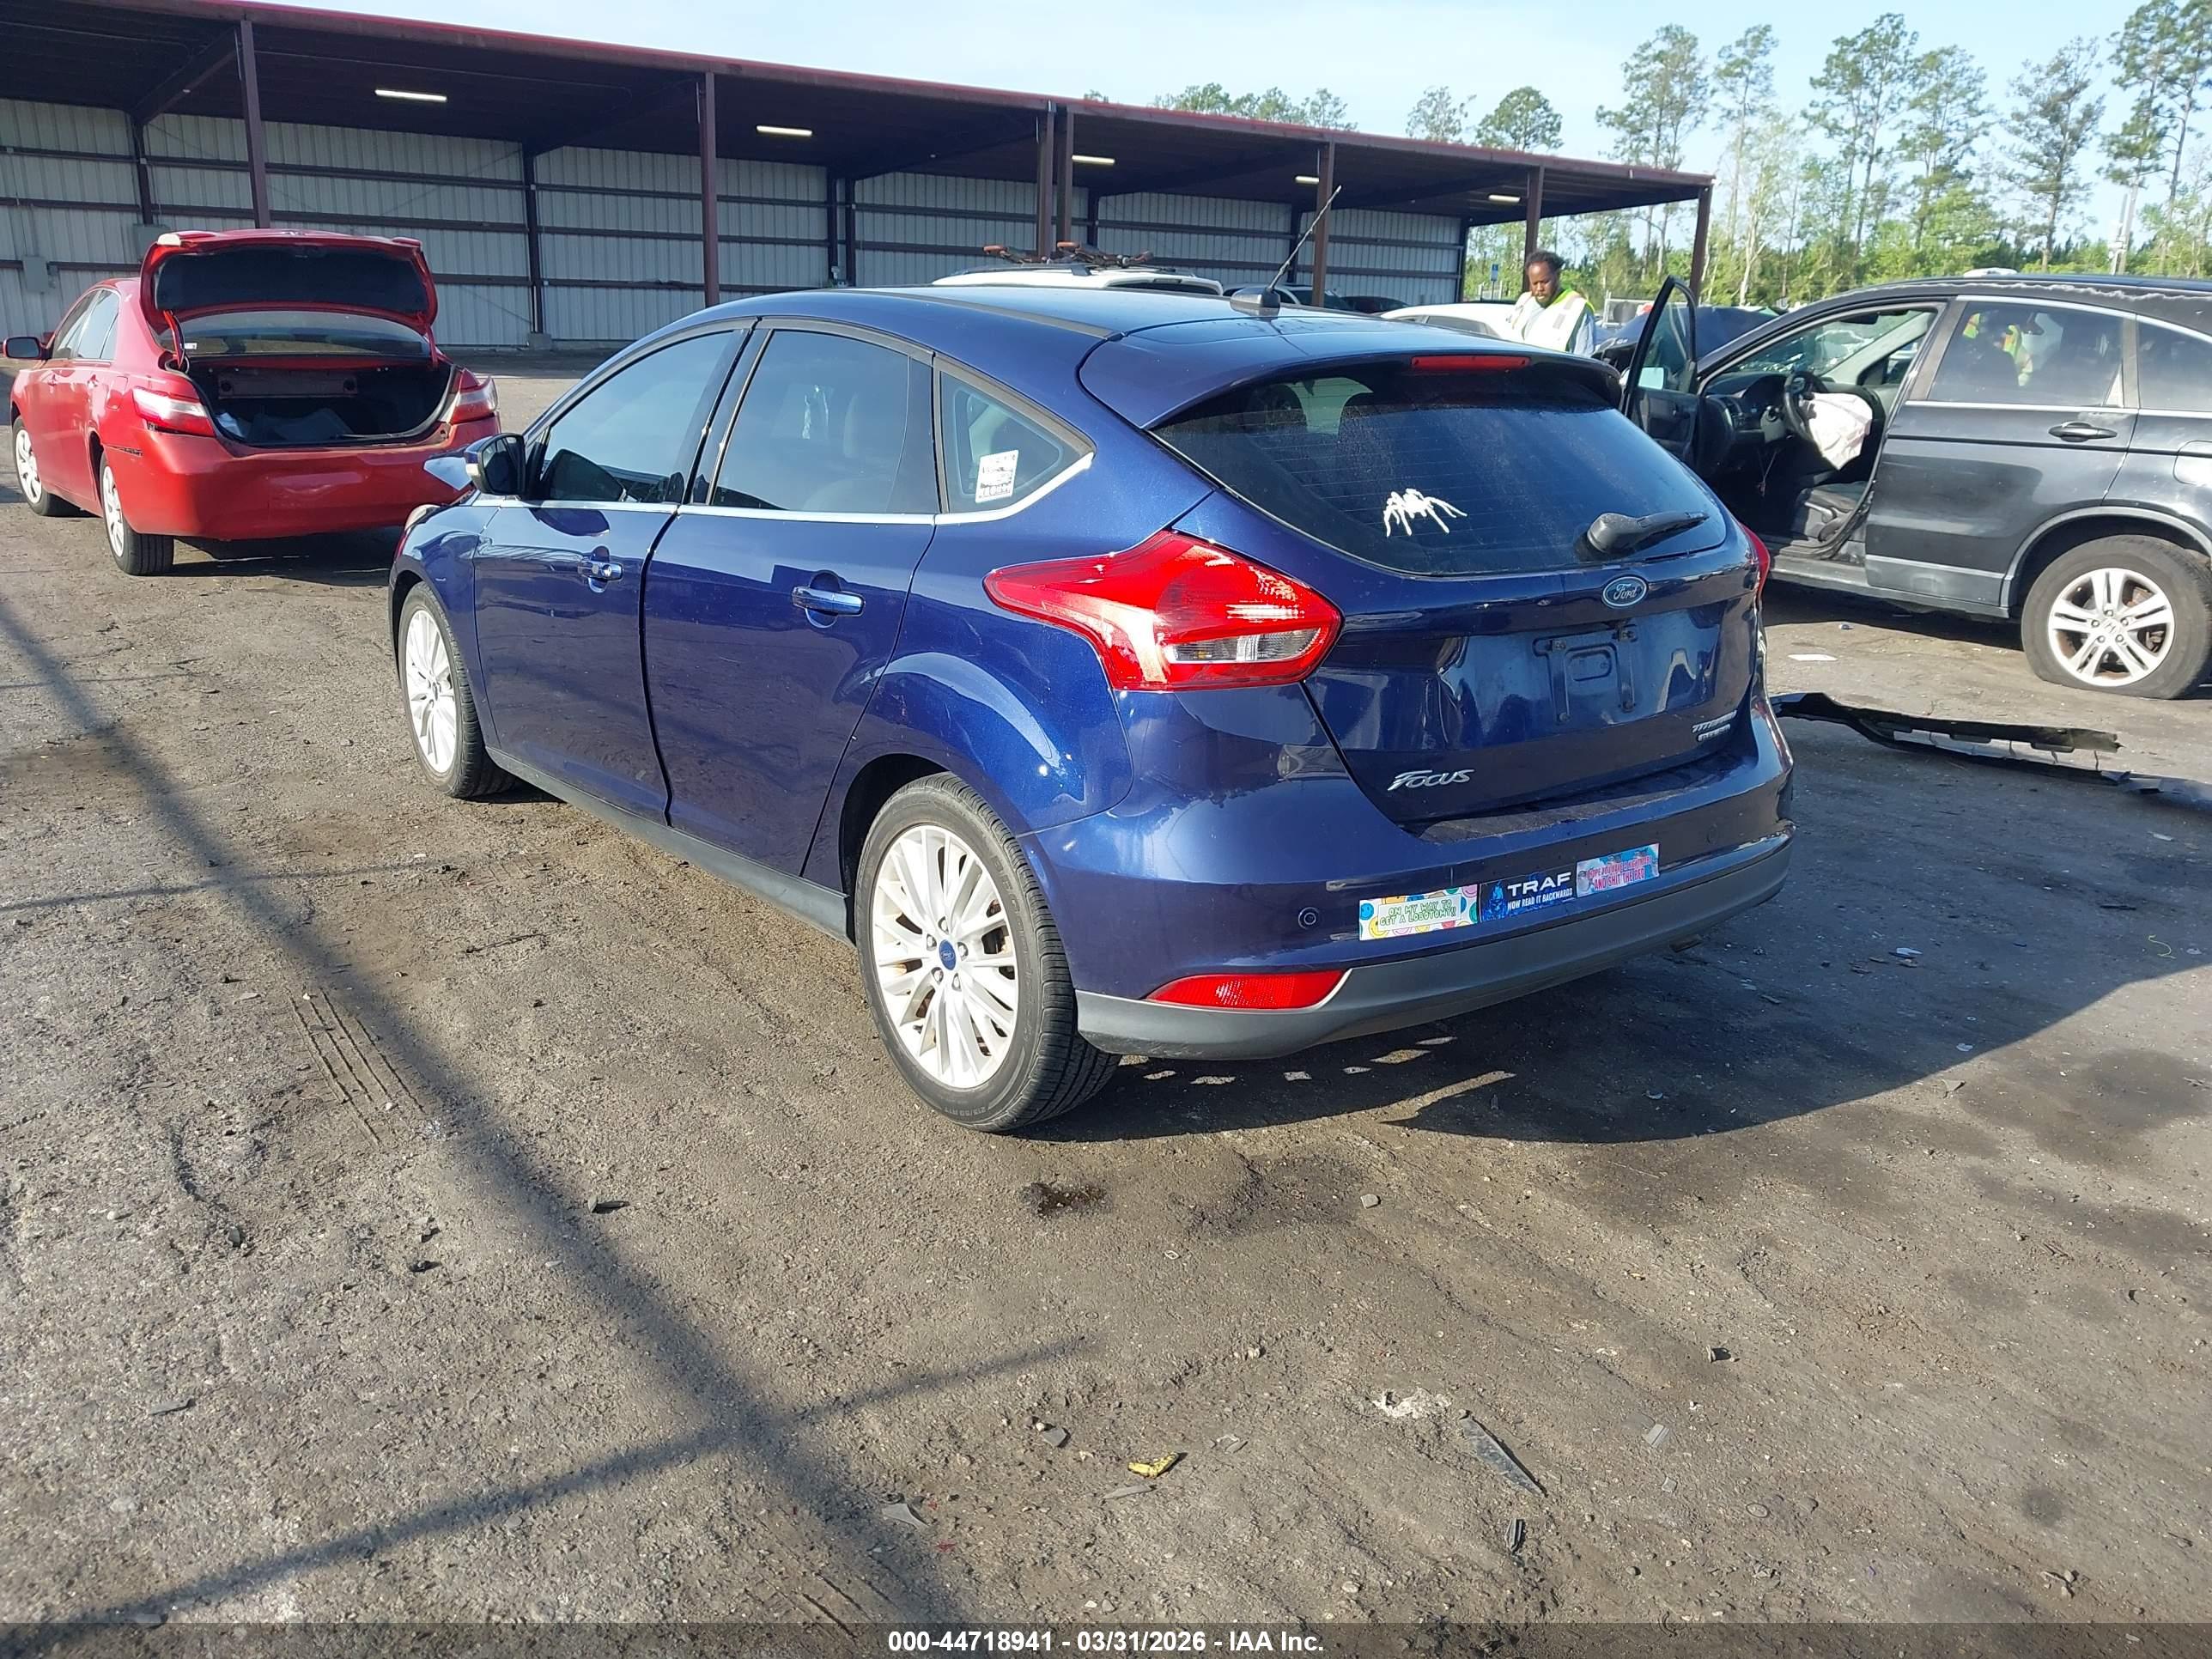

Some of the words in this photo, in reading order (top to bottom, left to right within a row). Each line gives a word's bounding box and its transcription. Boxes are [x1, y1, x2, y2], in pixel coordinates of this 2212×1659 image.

[1507, 872, 1571, 897] TRAF
[1594, 877, 1607, 891] AND
[1607, 874, 1621, 886] SHIT
[1622, 872, 1633, 883] THE
[1389, 907, 1401, 916] ON
[1405, 904, 1418, 914] MY
[1420, 902, 1438, 912] WAY
[1442, 900, 1451, 908] TO
[1508, 899, 1521, 910] NOW
[1522, 897, 1535, 908] READ
[1535, 896, 1541, 904] IT
[1542, 887, 1573, 903] BACKWARDS
[1380, 915, 1396, 926] GET
[1399, 914, 1406, 923] A
